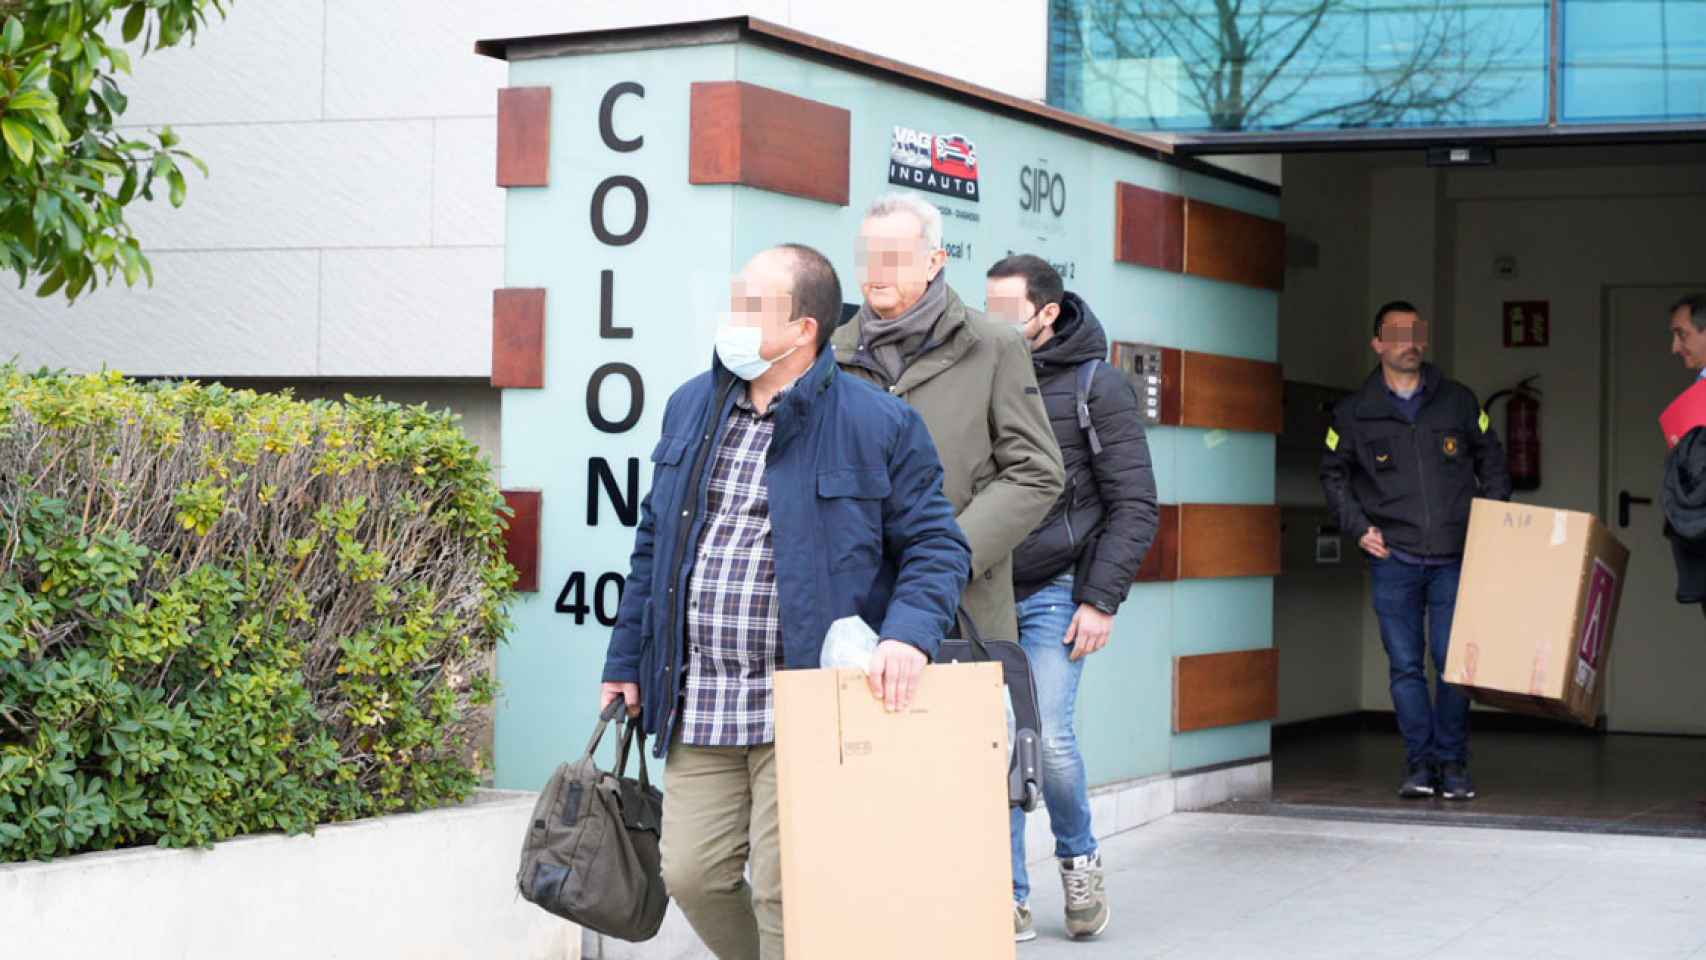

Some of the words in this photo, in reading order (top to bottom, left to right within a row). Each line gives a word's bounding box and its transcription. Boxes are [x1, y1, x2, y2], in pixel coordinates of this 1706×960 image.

[1020, 165, 1066, 218] SIPO
[586, 81, 648, 527] COLON
[556, 571, 626, 626] 40
